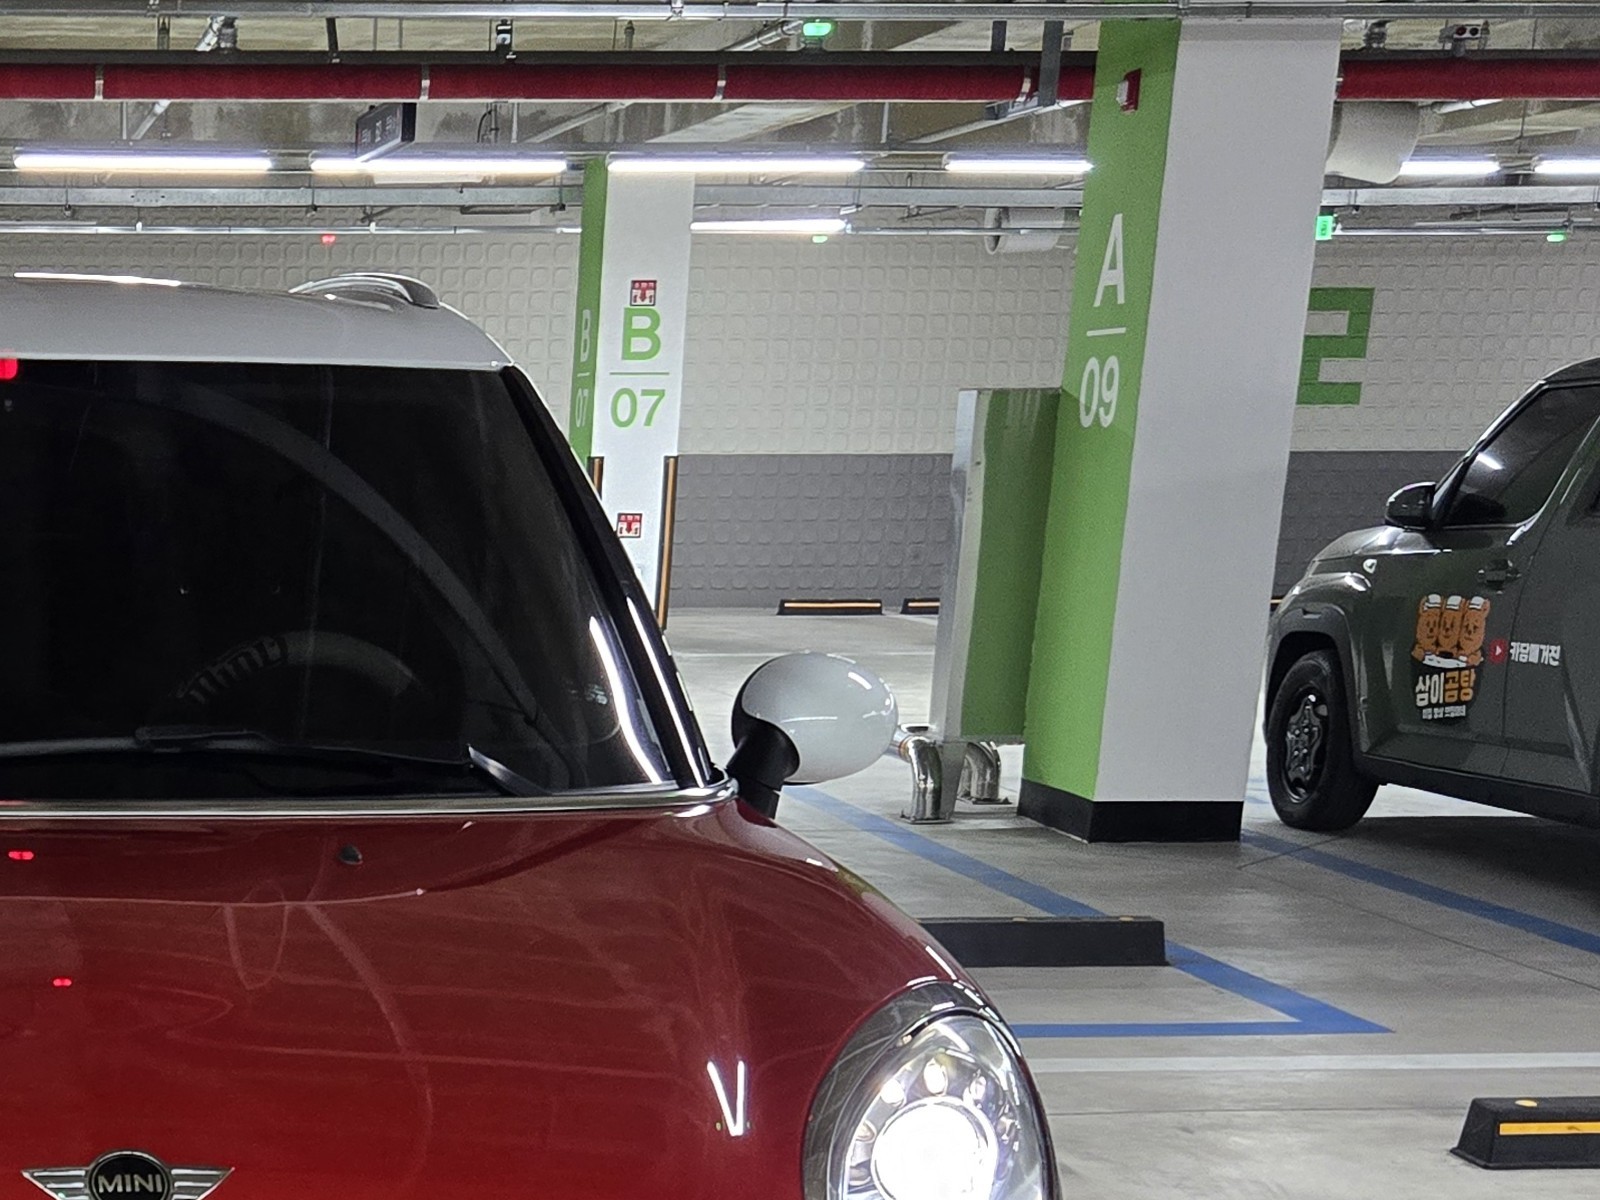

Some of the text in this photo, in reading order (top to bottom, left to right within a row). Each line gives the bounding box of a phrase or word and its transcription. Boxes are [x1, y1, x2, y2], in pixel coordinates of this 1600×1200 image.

[1093, 213, 1125, 307] A
[580, 309, 591, 363] B
[621, 307, 662, 361] B
[575, 388, 589, 428] 07
[610, 387, 666, 428] 07
[1079, 355, 1120, 428] 09
[1415, 668, 1476, 707] 삼이곰탕
[97, 1173, 163, 1193] MINI
